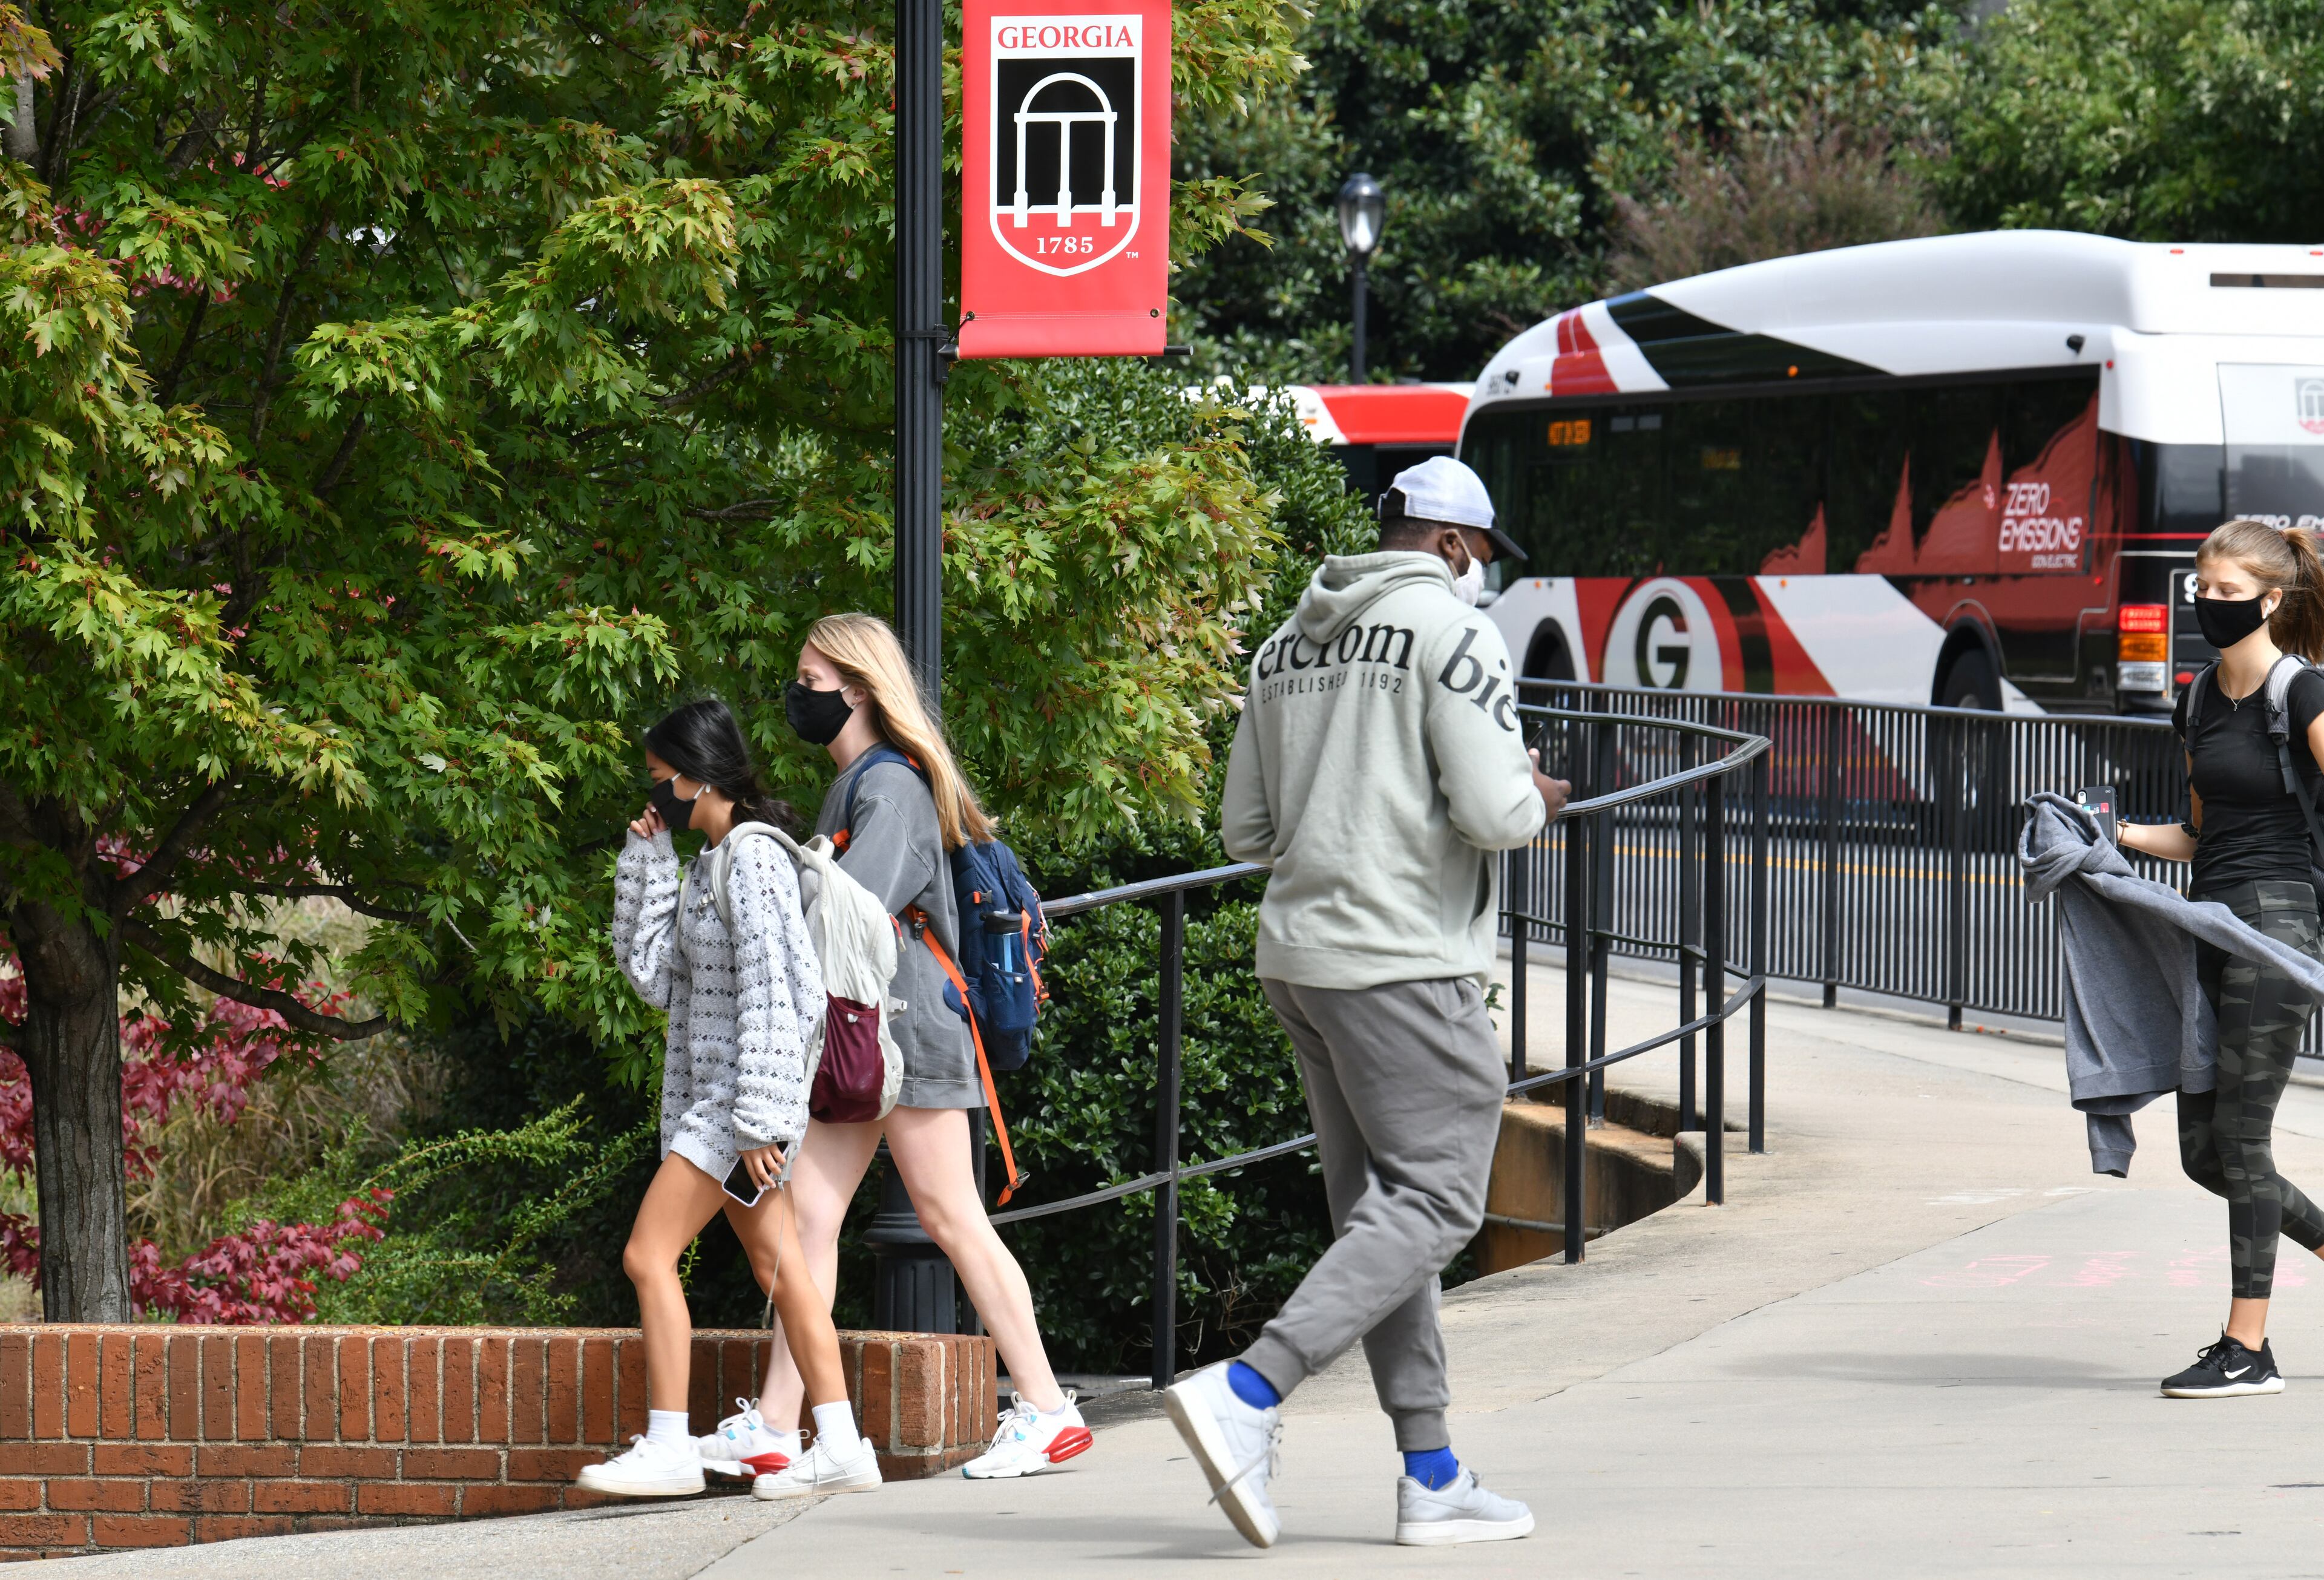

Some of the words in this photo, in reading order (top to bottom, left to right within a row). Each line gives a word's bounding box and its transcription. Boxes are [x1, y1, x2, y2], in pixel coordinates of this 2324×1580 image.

[997, 25, 1134, 49] GEORGIA
[1036, 237, 1094, 254] 1785
[2004, 482, 2050, 517] ZERO
[1998, 516, 2083, 552] EMISSIONS
[1635, 595, 1690, 689] G
[1361, 672, 1402, 694] 1892
